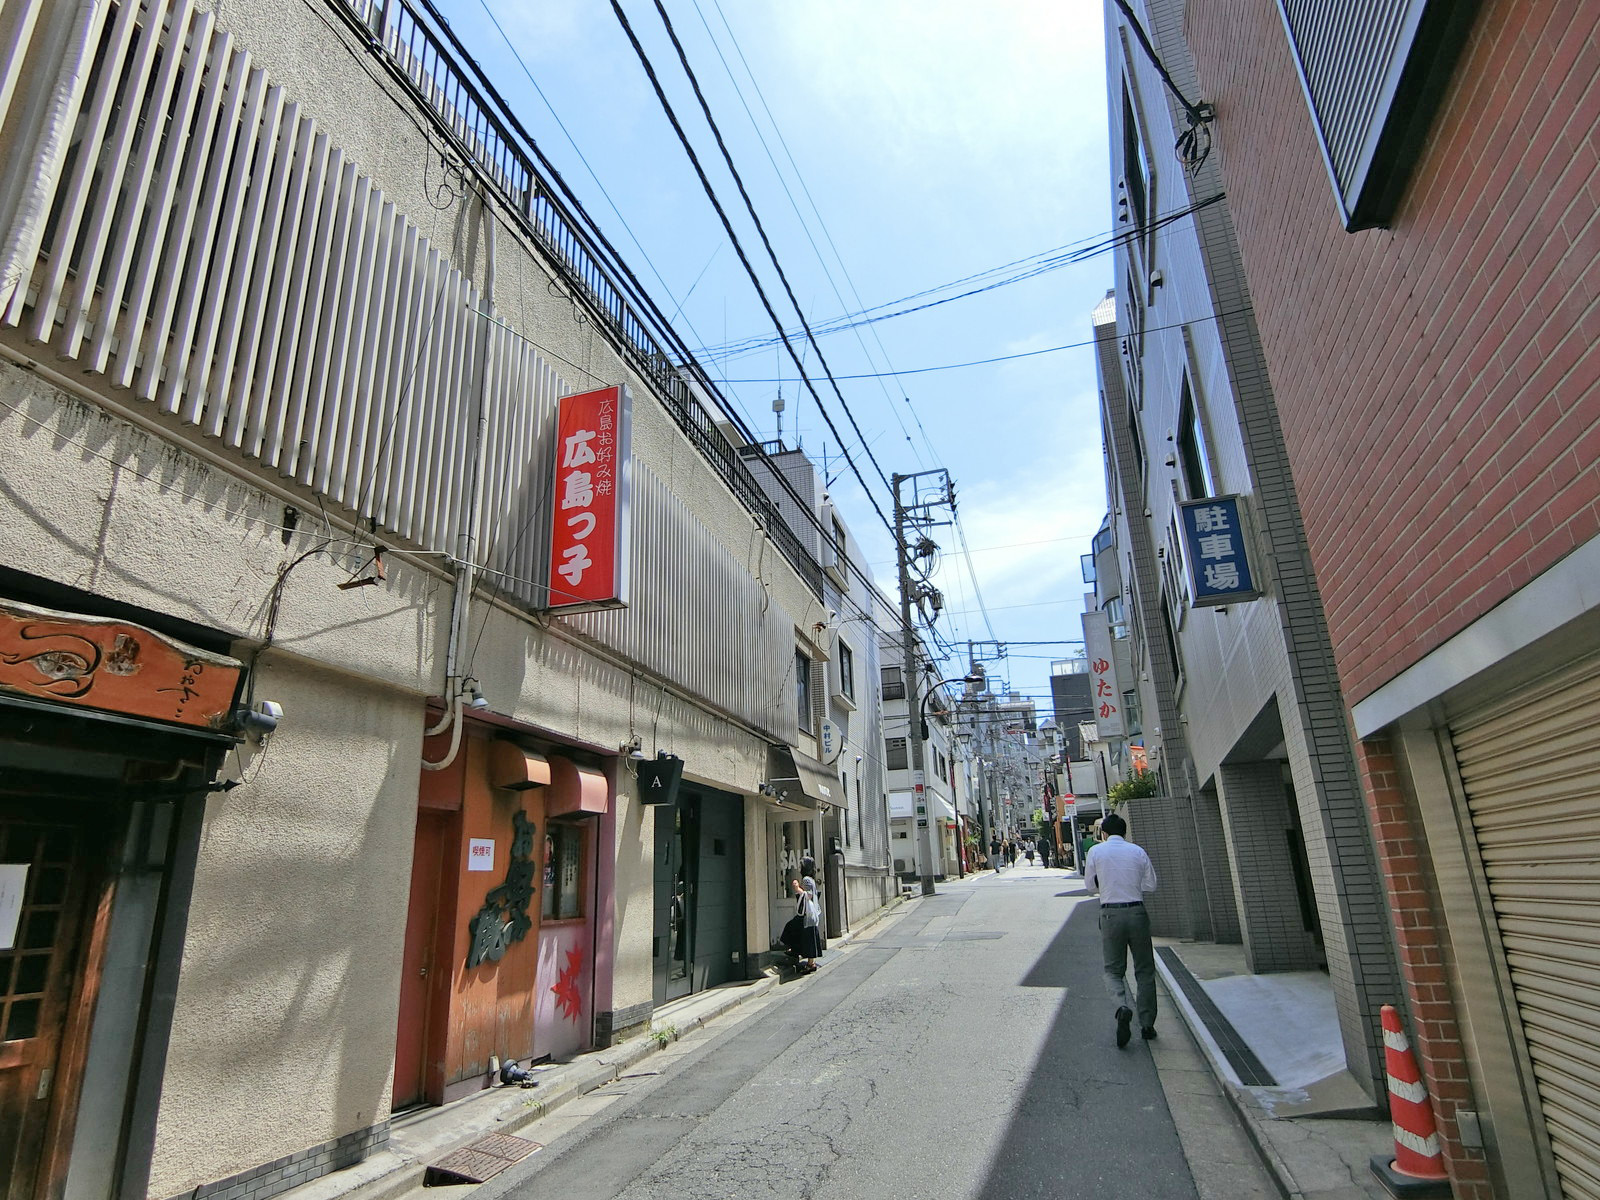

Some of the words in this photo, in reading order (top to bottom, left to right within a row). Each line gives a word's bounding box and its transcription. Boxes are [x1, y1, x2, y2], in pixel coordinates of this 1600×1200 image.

[595, 399, 614, 497] 広島お好み焼
[1193, 504, 1240, 591] 駐車場
[1092, 657, 1117, 719] ゆたか
[822, 723, 833, 755] 中村ビル
[651, 776, 662, 788] A
[472, 845, 491, 858] 喫煙可
